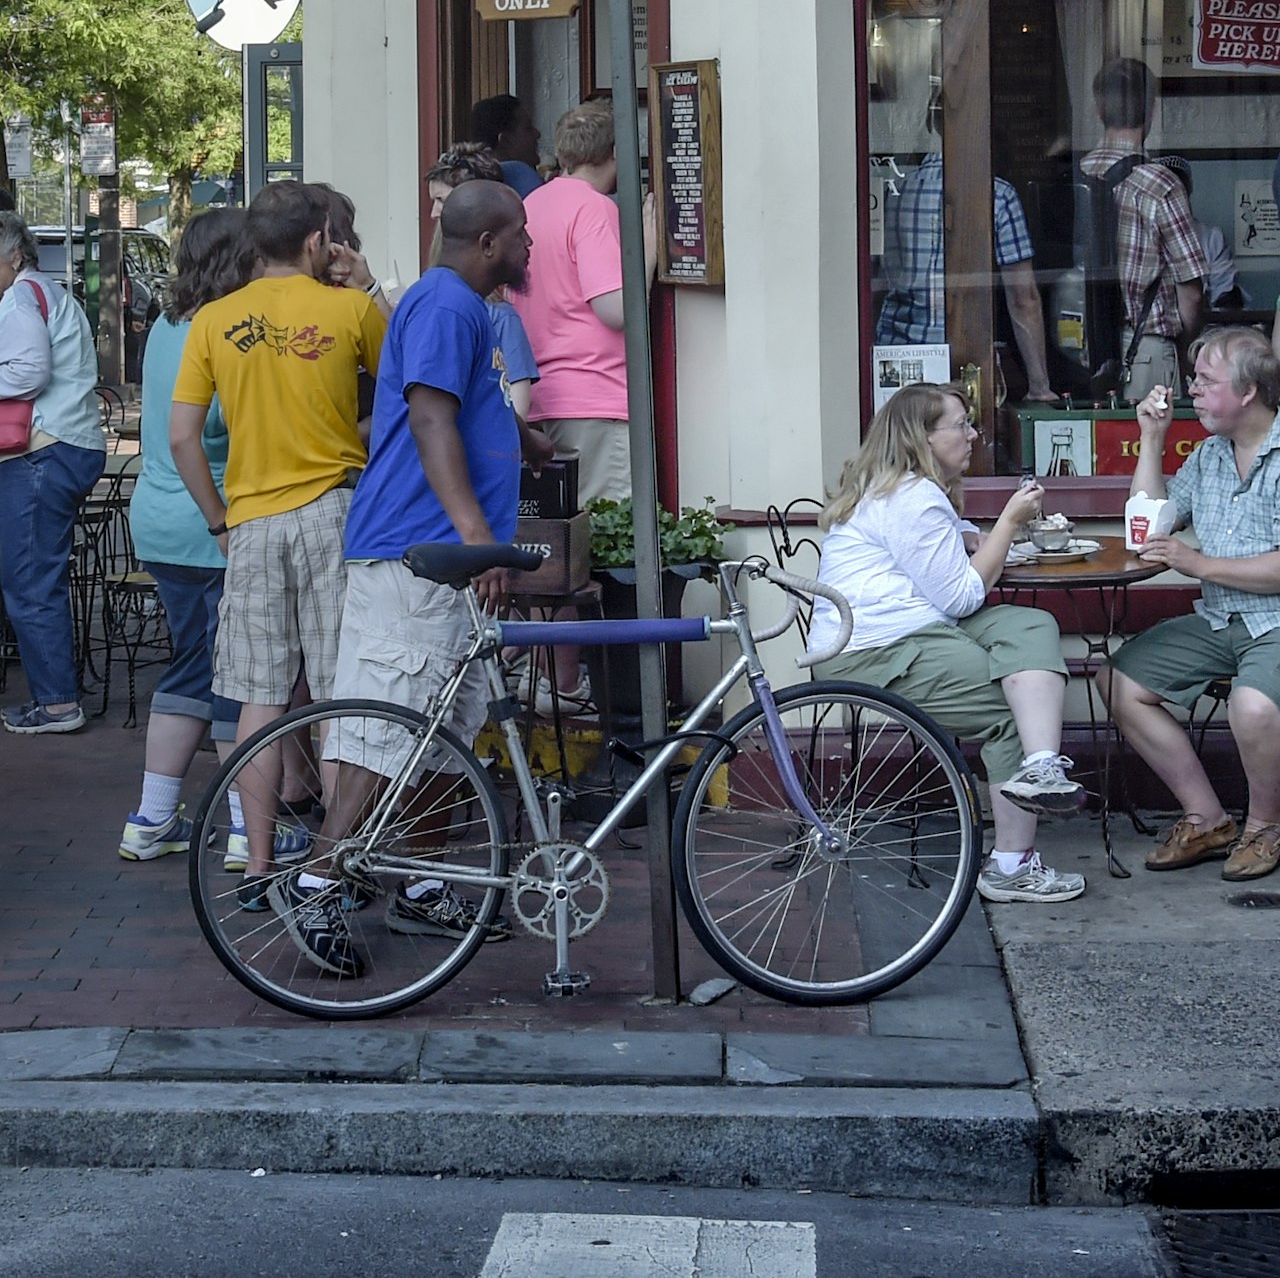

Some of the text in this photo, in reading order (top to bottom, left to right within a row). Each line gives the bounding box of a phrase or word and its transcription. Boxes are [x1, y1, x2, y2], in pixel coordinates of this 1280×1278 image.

[1208, 23, 1255, 42] PICK
[875, 349, 947, 358] AMERICAN LIFESTYLE
